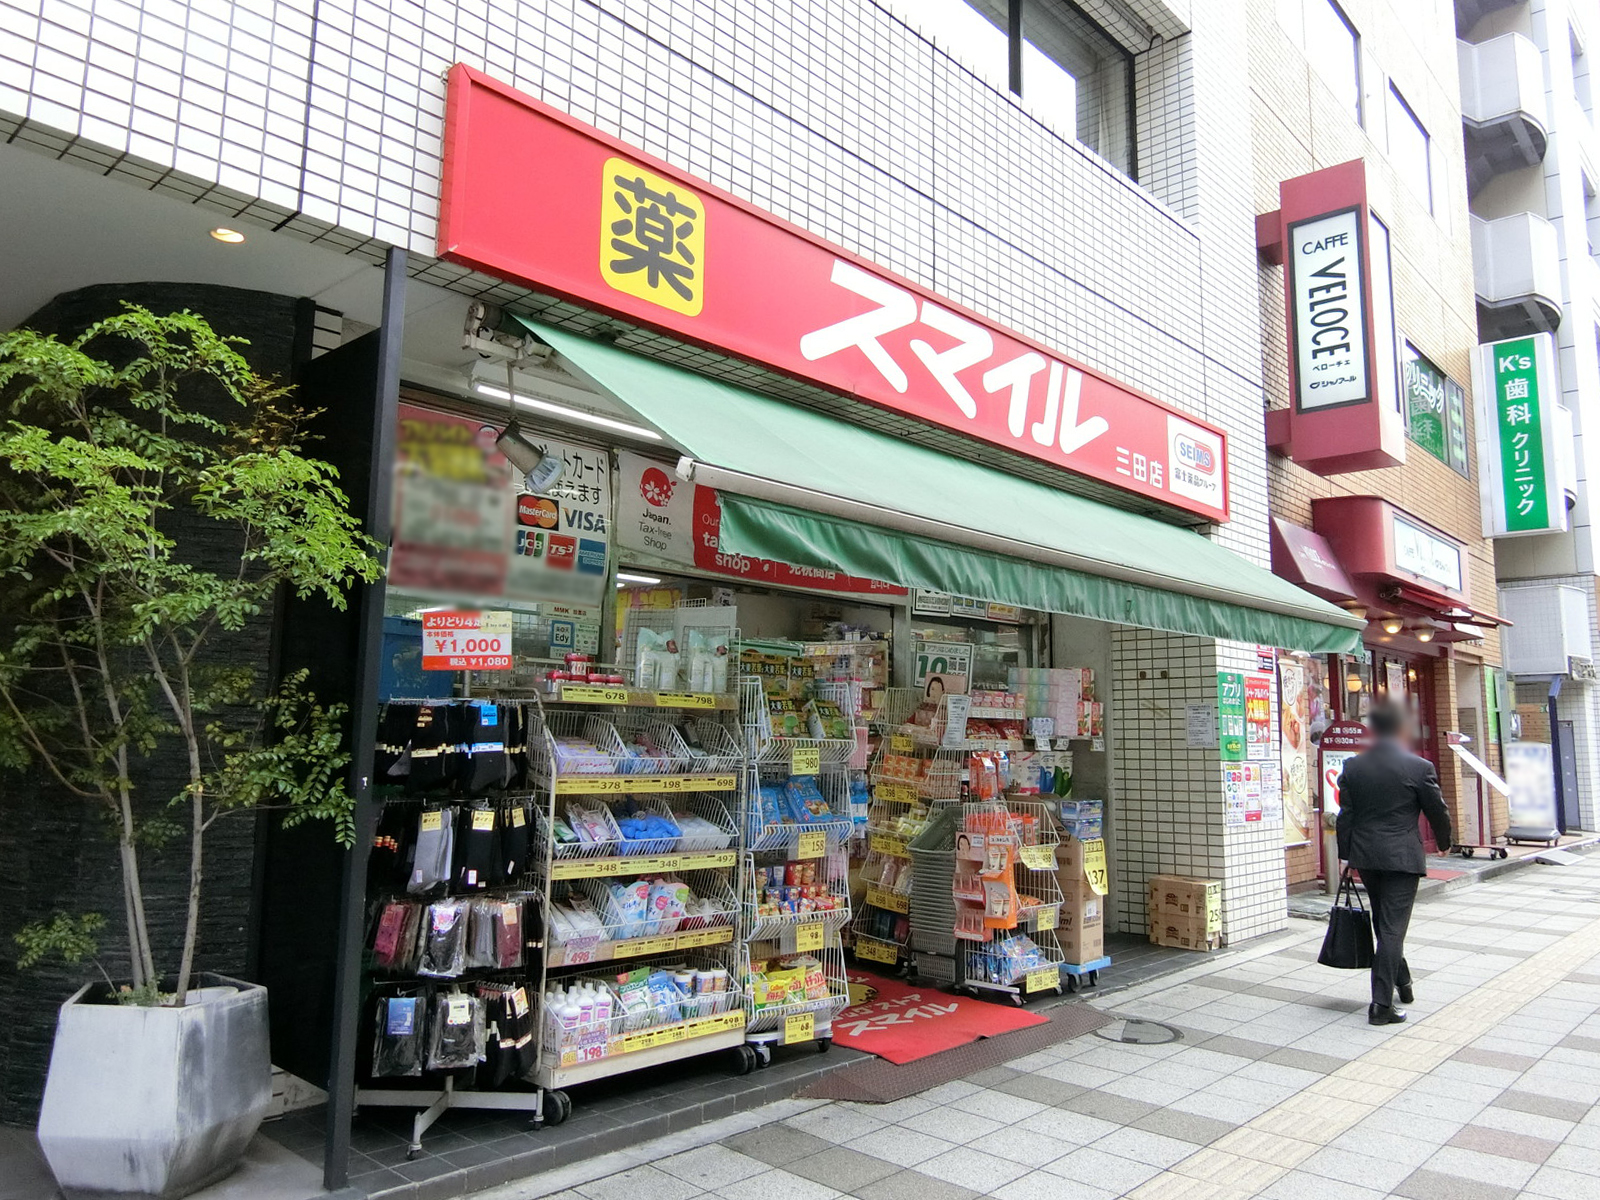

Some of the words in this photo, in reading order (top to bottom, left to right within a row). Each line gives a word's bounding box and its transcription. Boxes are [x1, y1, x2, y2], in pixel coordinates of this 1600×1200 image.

[610, 174, 697, 303] 薬
[1302, 232, 1349, 255] CAFFE
[1309, 256, 1351, 360] VELOCE
[800, 258, 1109, 456] スマイル
[1312, 359, 1351, 372] ベローチェ
[1499, 355, 1531, 374] K's
[1504, 377, 1534, 516] 歯科クリニック
[1179, 442, 1210, 467] SEIMS
[1115, 446, 1163, 489] 三田店
[518, 504, 558, 520] MasterCard
[562, 507, 607, 534] VISA
[638, 521, 673, 540] Tax-free
[518, 538, 543, 550] JCB
[643, 535, 668, 552] Shop
[715, 553, 751, 574] shop
[555, 634, 570, 643] Edy
[435, 638, 502, 654] ¥1,000
[470, 657, 509, 667] ¥1,080
[605, 691, 626, 700] 678
[695, 696, 714, 705] 798
[805, 757, 818, 769] 980
[600, 781, 621, 790] 378
[662, 780, 681, 789] 198
[716, 779, 734, 787] 698
[811, 840, 825, 852] 158
[660, 860, 678, 868] 348
[716, 855, 734, 863] 497
[597, 863, 617, 872] 348
[809, 931, 819, 940] 98
[571, 951, 590, 963] 498
[723, 1017, 740, 1026] 498
[837, 1002, 960, 1036] スマイル
[800, 1022, 810, 1032] 68
[582, 1046, 603, 1061] 198
